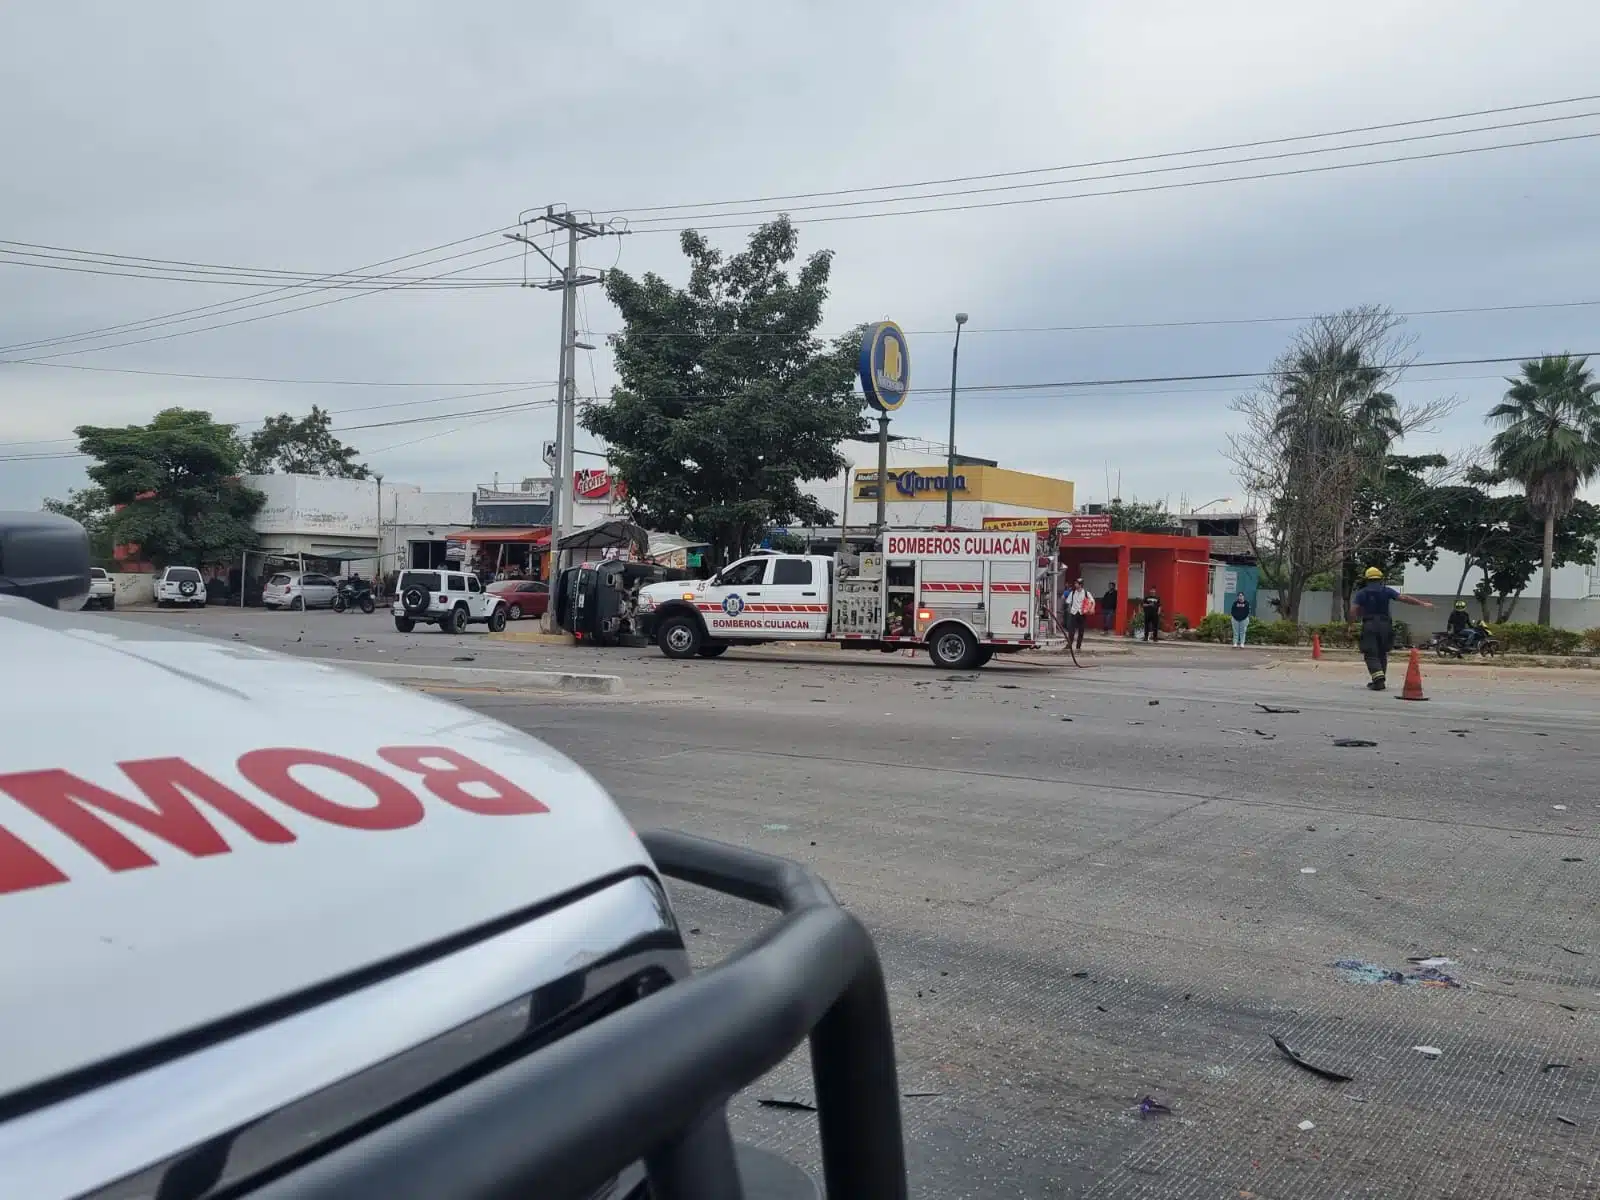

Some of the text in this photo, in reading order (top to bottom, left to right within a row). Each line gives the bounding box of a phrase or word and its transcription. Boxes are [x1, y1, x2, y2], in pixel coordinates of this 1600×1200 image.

[896, 470, 967, 497] Corona
[888, 534, 1030, 554] BOMBEROS CULIACÁN
[696, 582, 706, 592] 45
[713, 619, 762, 628] BOMBEROS
[1011, 610, 1027, 628] 45
